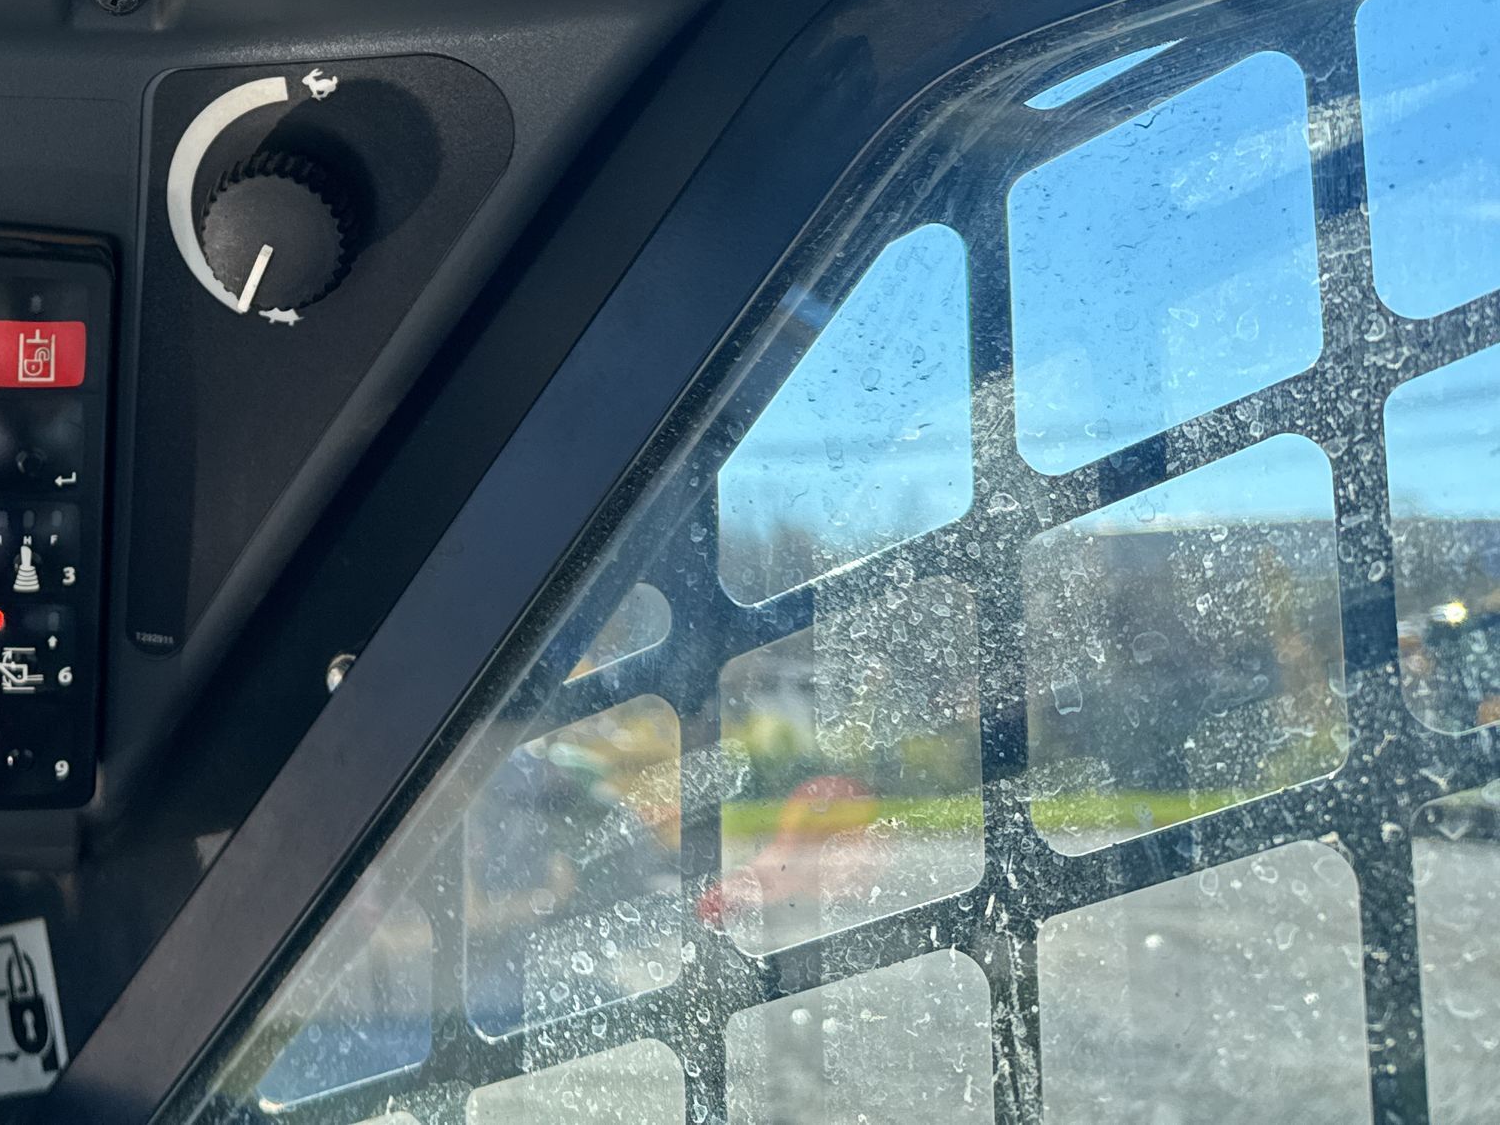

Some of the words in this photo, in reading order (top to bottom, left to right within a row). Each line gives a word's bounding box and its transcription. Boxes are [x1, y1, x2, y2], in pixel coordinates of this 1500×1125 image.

[62, 566, 76, 586] 3
[57, 667, 73, 686] 6
[55, 760, 70, 780] 9
